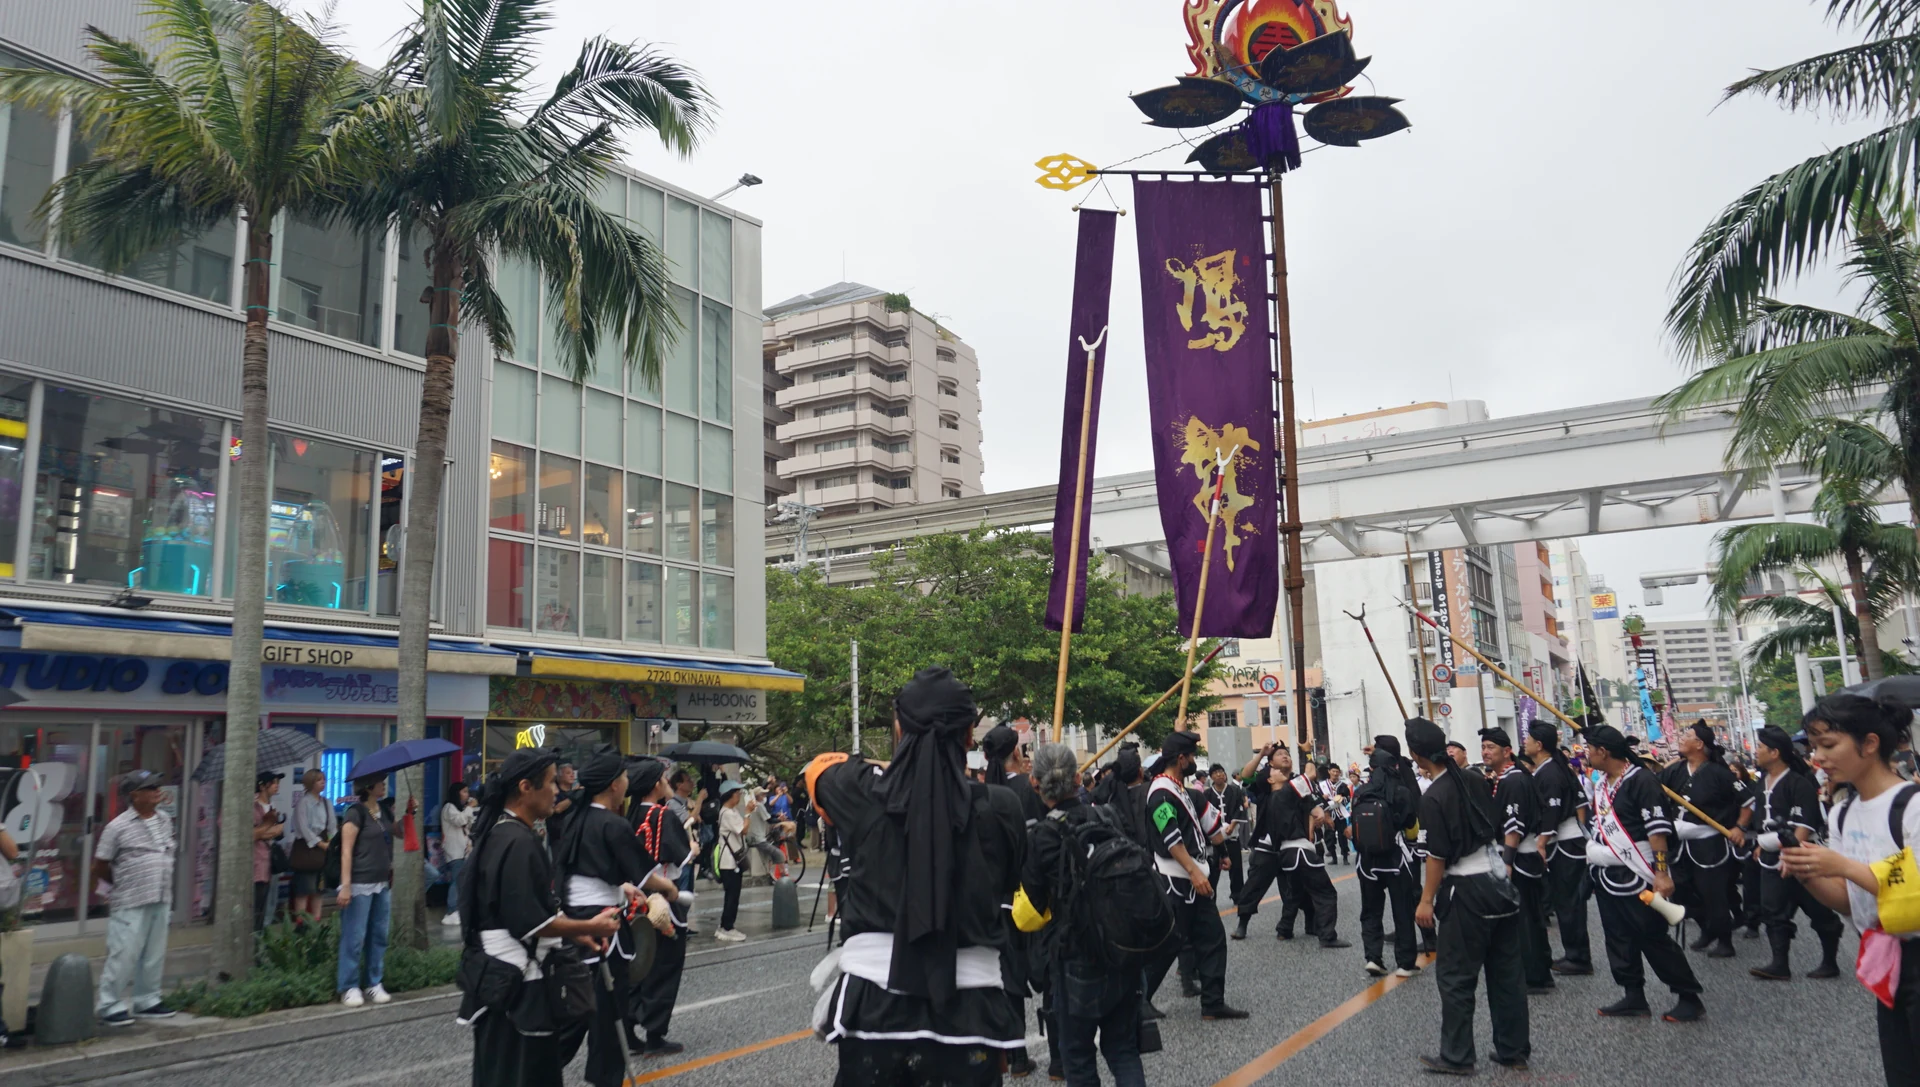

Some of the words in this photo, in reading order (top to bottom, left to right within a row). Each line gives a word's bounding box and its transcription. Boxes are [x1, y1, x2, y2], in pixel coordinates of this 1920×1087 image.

[263, 645, 303, 663] GIFT
[307, 648, 354, 665] SHOP
[161, 661, 229, 696] 80
[647, 669, 671, 683] 2720
[673, 671, 721, 686] OKINAWA
